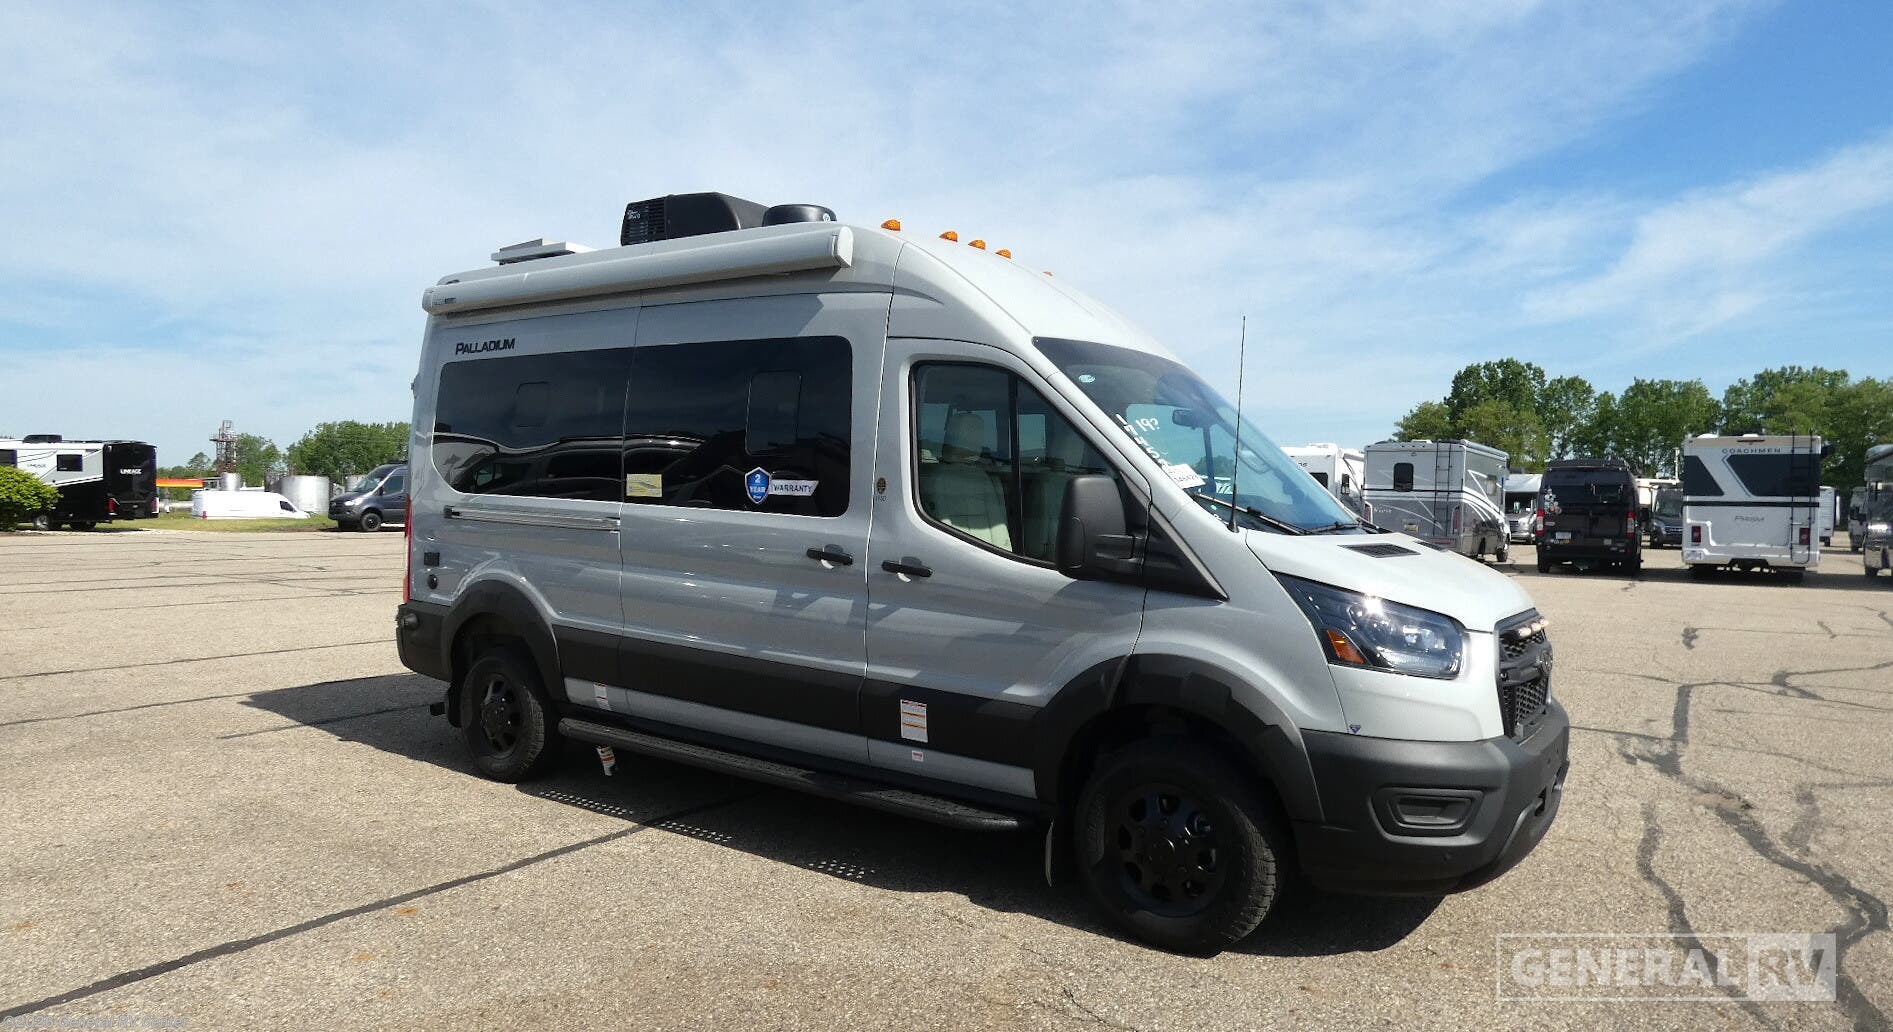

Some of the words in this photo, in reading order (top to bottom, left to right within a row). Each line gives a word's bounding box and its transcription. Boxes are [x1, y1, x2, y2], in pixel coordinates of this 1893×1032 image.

[455, 338, 516, 355] PALLADIUM
[1721, 447, 1781, 455] COACHMEN
[754, 473, 761, 484] 2
[749, 485, 766, 493] YEAR
[773, 484, 813, 493] WARRANTY
